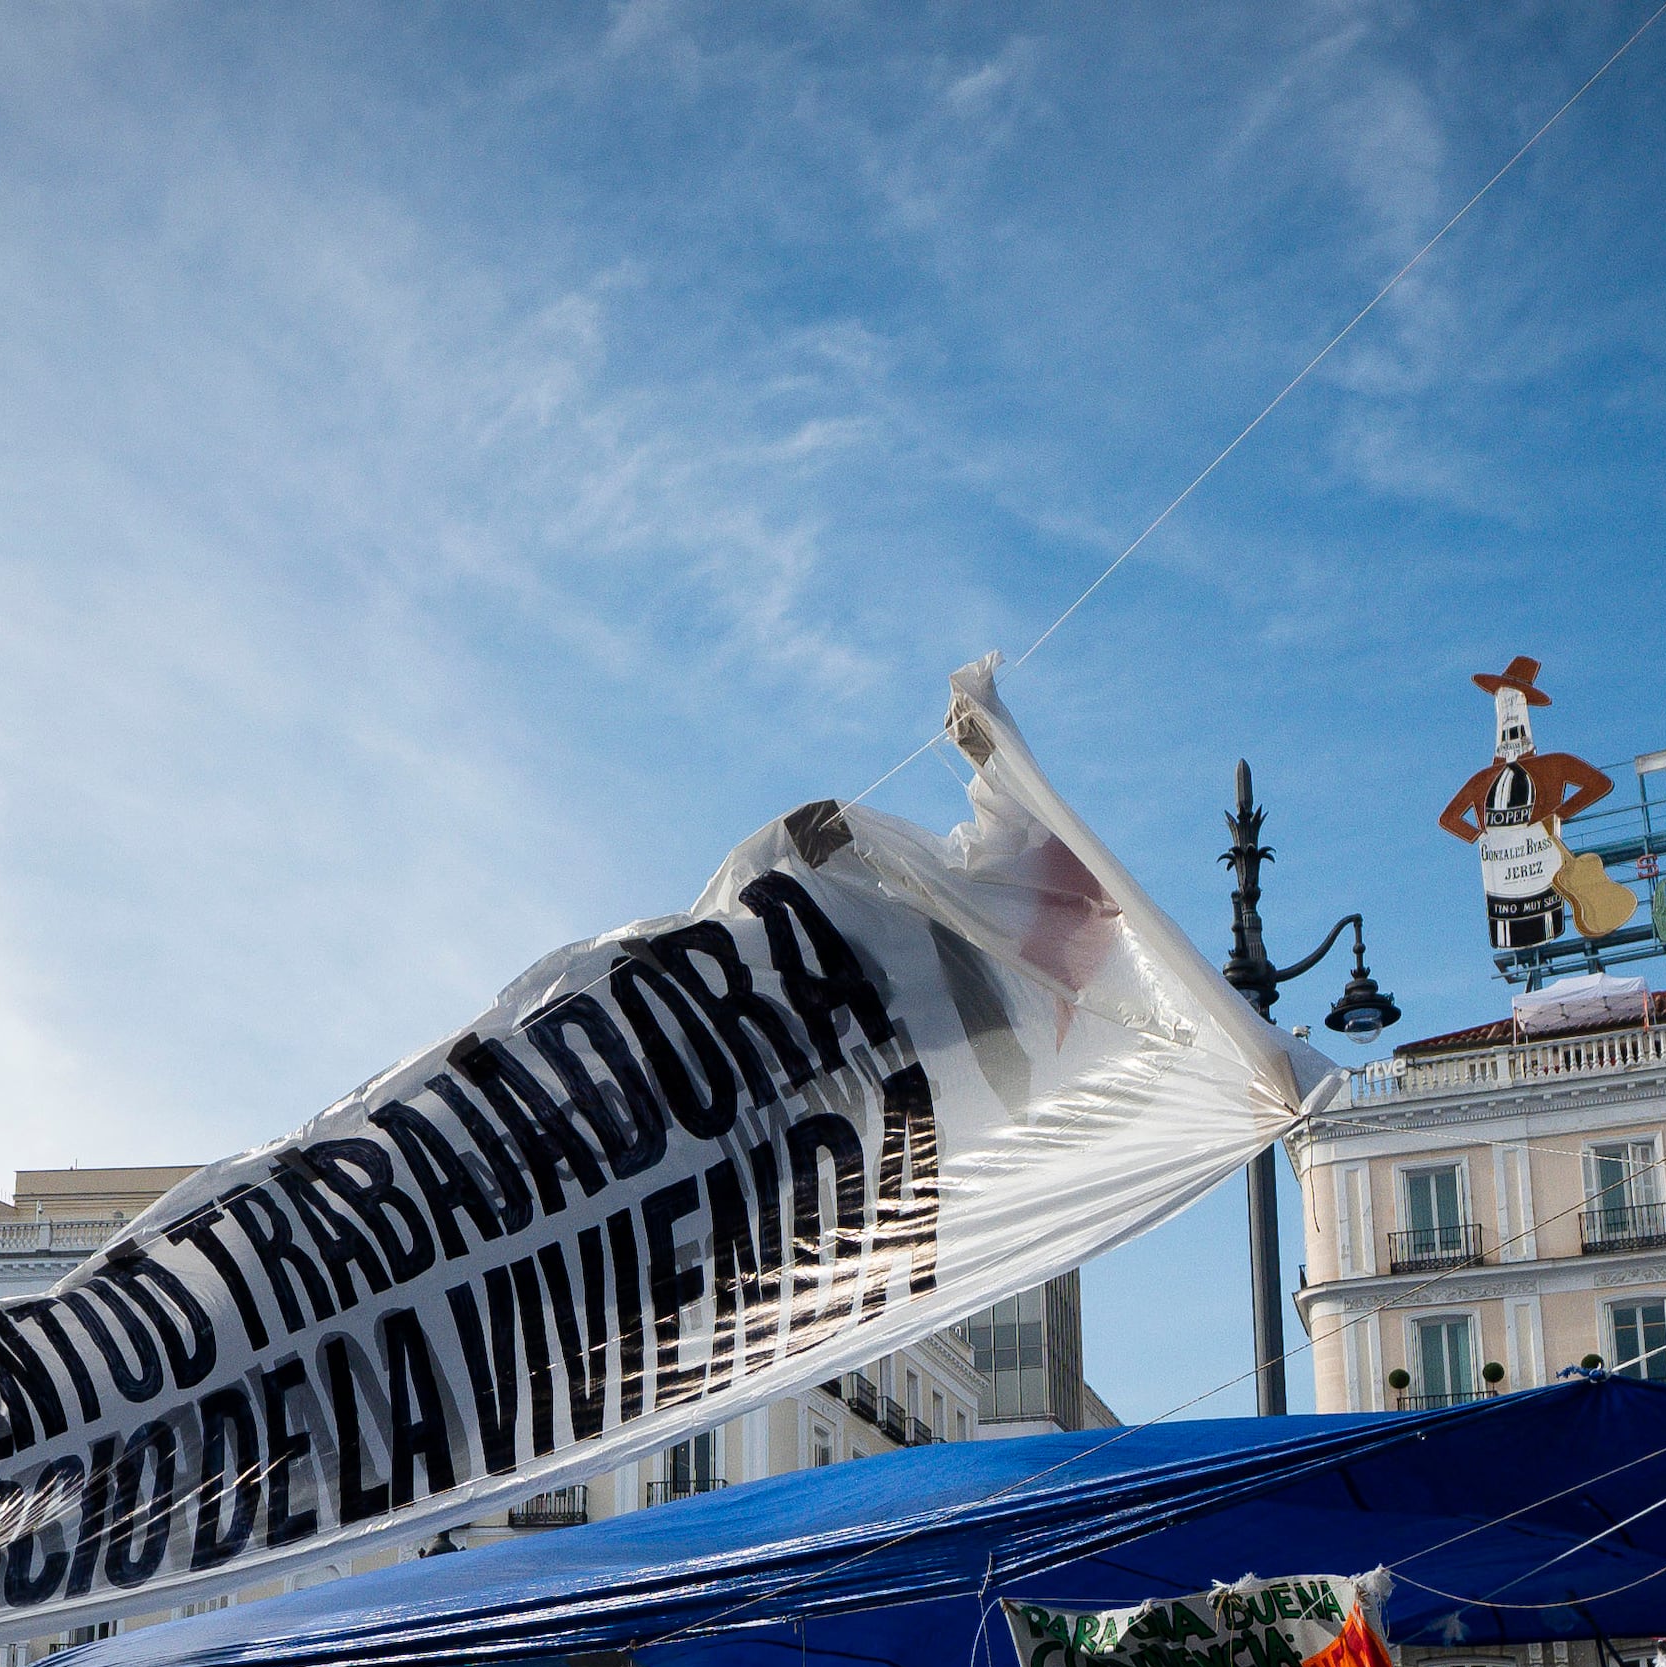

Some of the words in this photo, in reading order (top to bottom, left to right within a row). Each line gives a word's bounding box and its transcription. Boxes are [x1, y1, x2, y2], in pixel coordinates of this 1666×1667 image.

[1504, 860, 1544, 880] JEREZ
[1522, 898, 1543, 913] MUY
[167, 870, 897, 1351] TRABAJADORA
[189, 1358, 320, 1573] DE
[324, 1308, 457, 1525] LA
[446, 1060, 939, 1477] VIVIENDA
[1019, 1605, 1120, 1655] PARA
[1214, 1580, 1347, 1632] BUENA
